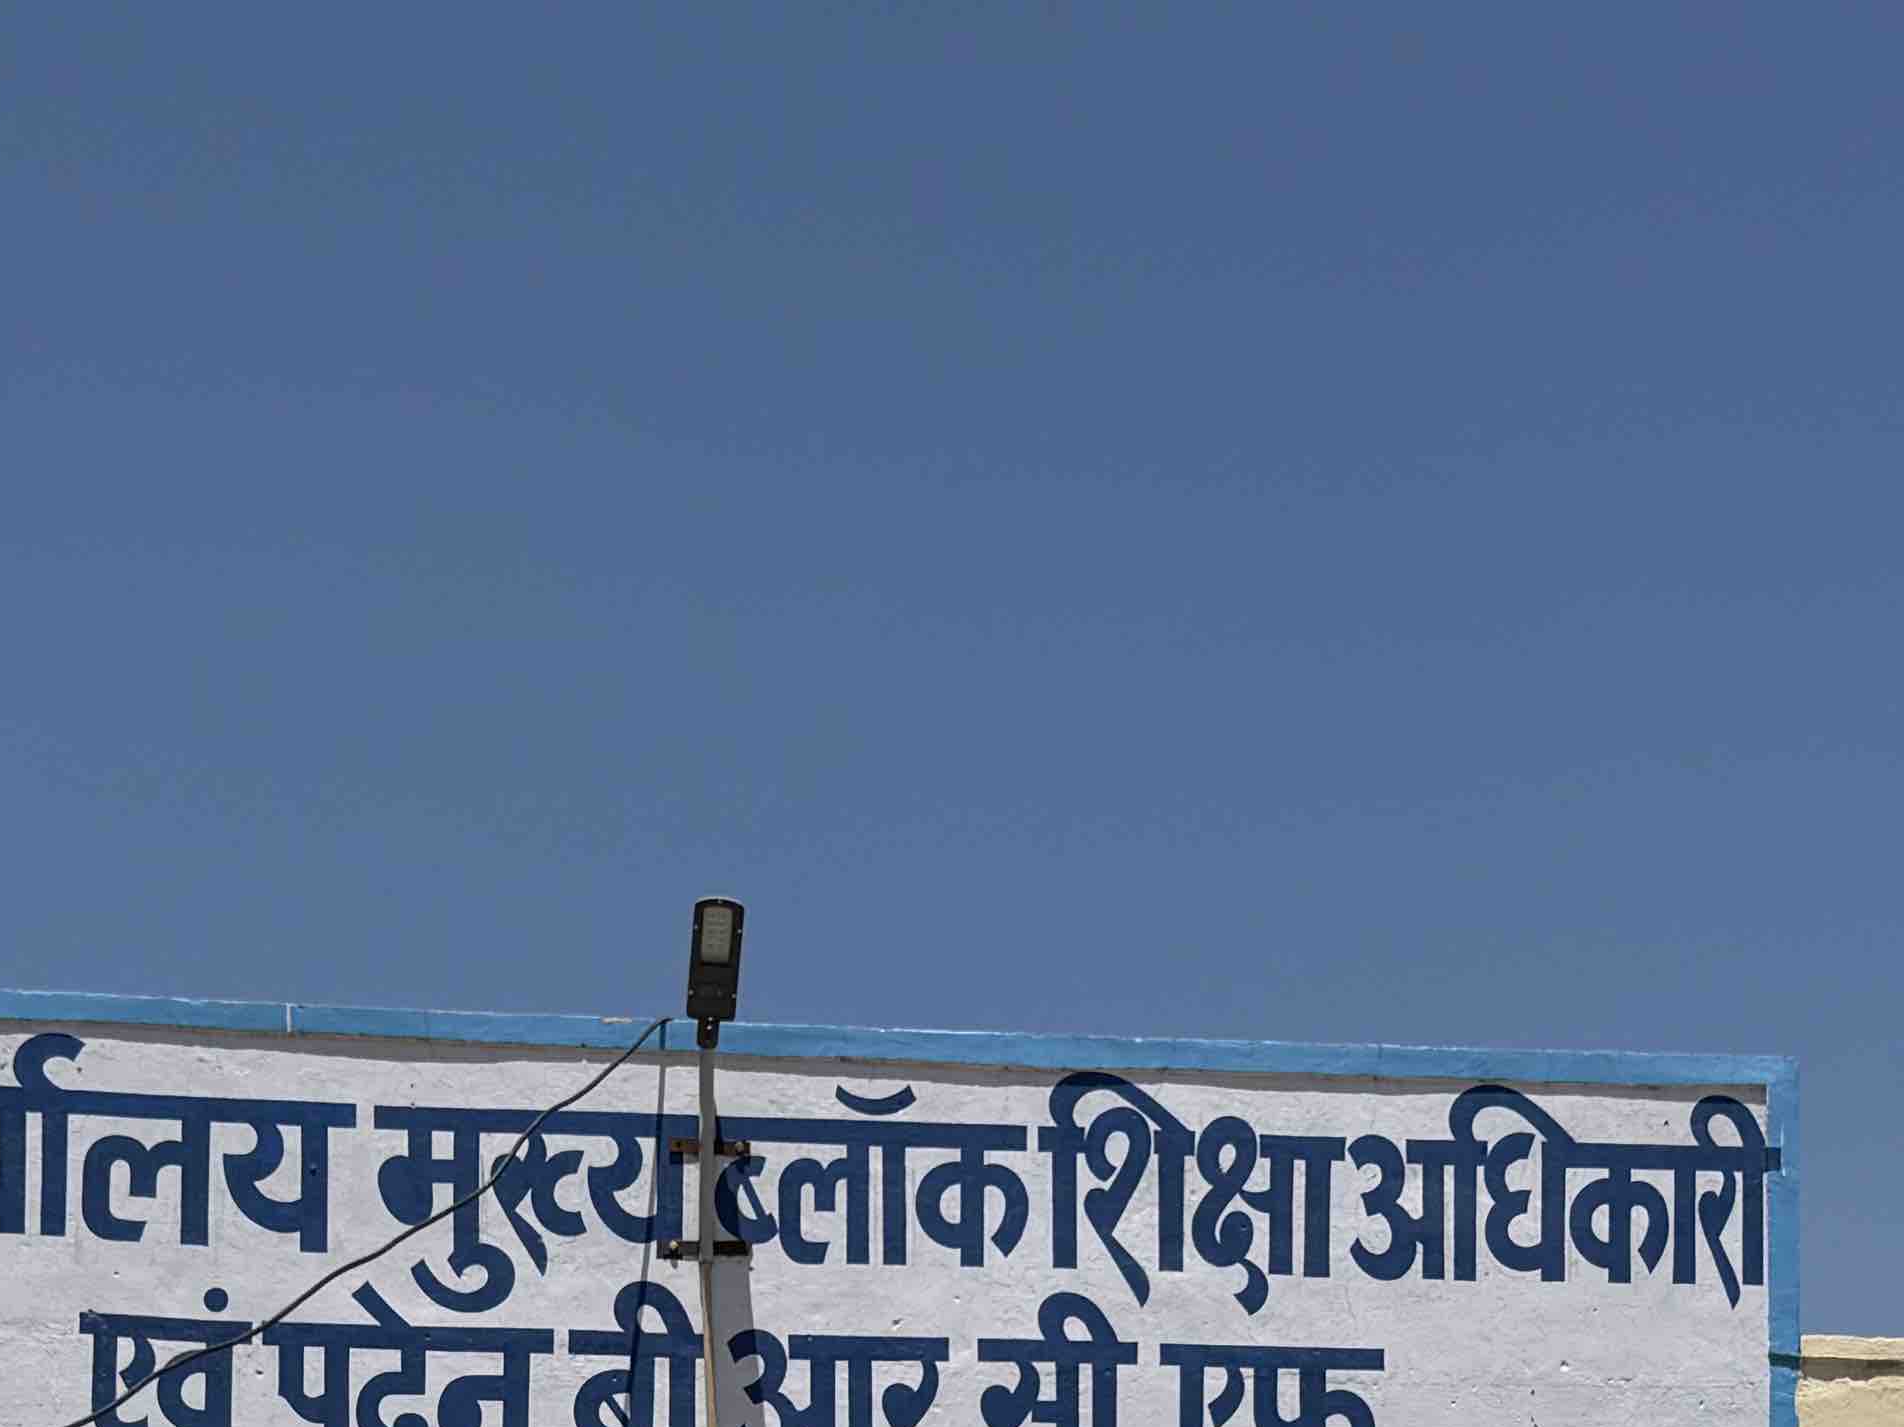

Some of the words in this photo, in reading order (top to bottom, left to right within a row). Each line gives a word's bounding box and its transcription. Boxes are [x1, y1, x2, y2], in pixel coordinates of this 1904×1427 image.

[373, 1105, 700, 1313] मुख्य
[714, 1084, 1029, 1267] ब्लॉक
[1038, 1072, 1346, 1315] शिक्षा
[1348, 1085, 1783, 1308] अधिकारी
